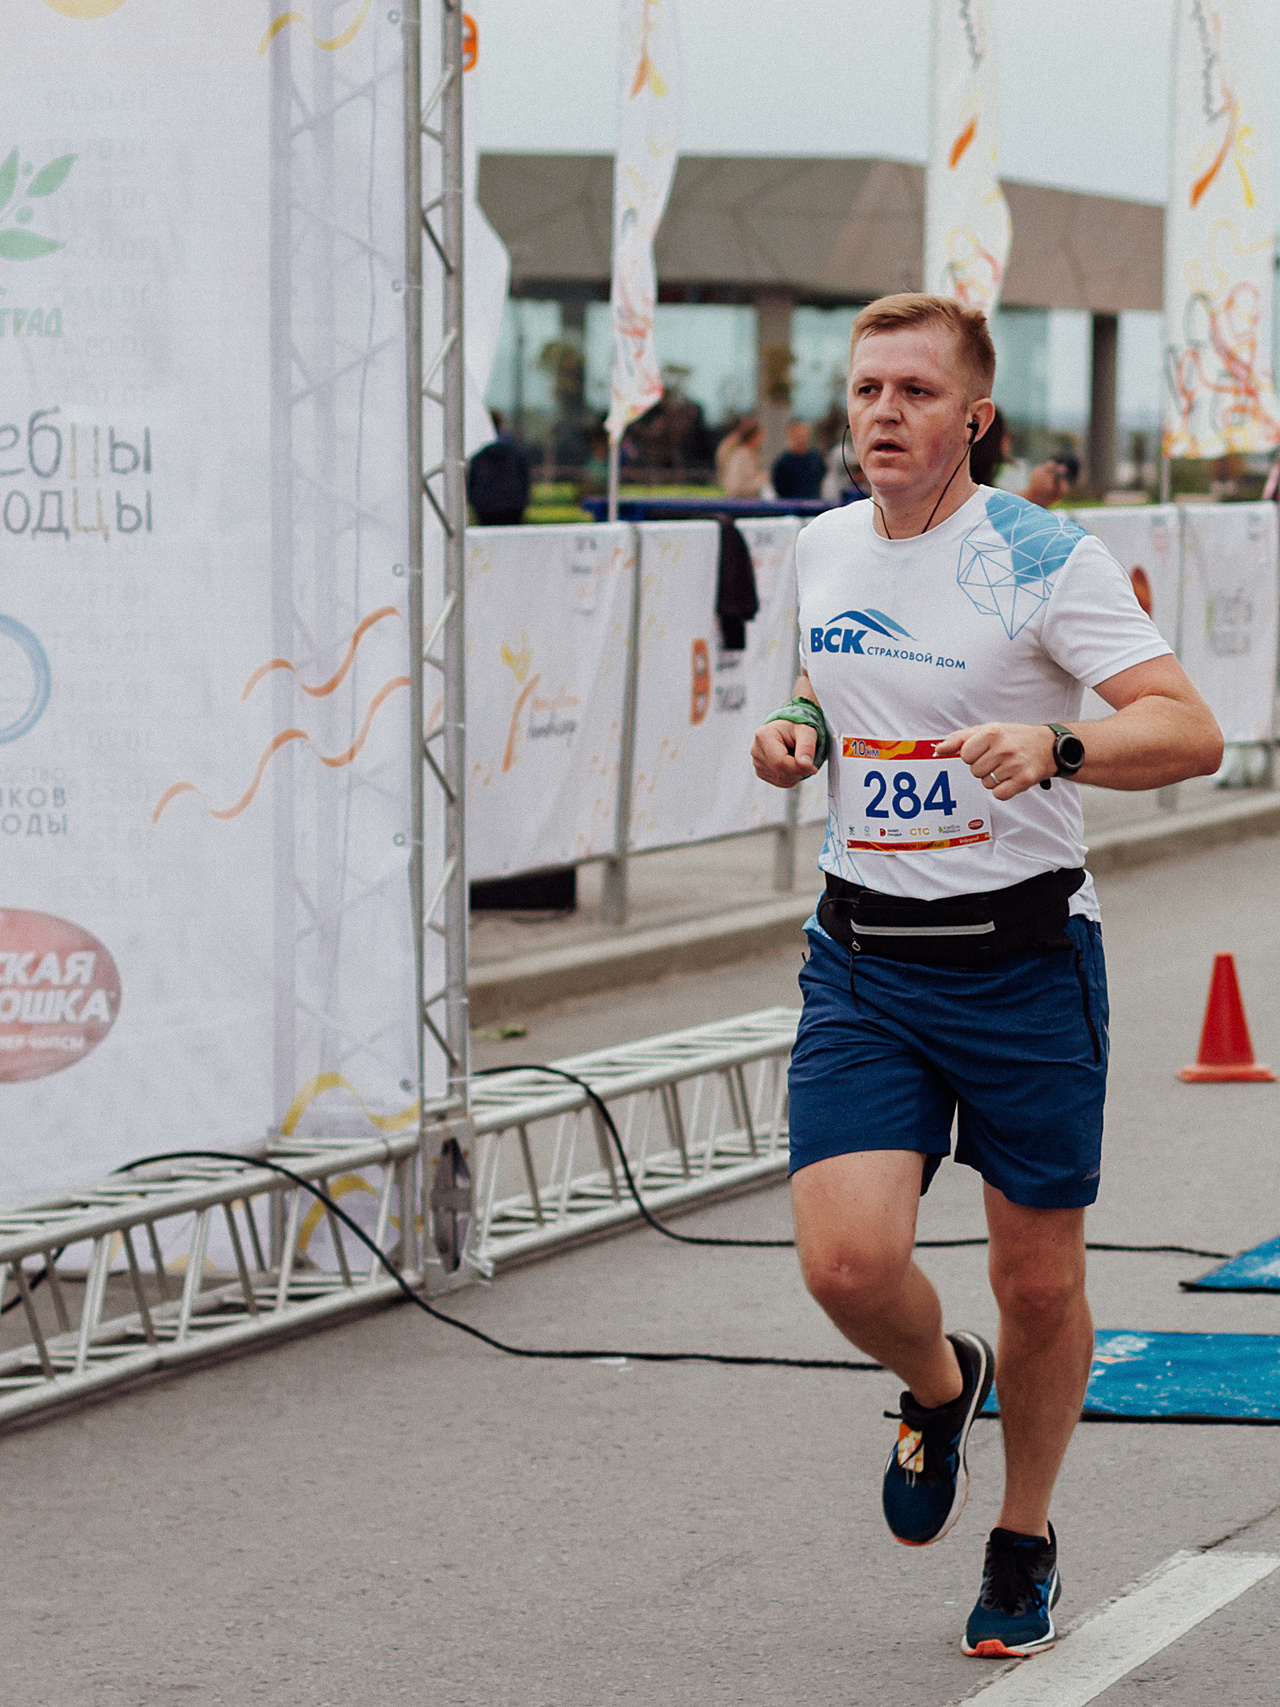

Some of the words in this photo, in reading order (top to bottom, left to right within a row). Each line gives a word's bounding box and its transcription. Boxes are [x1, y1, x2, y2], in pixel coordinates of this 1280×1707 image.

[810, 627, 868, 655] ВСК
[867, 646, 932, 664] СТРАХОВОЙ
[935, 656, 966, 669] ДОМ
[0, 786, 66, 808] КОВ
[863, 770, 957, 820] 284
